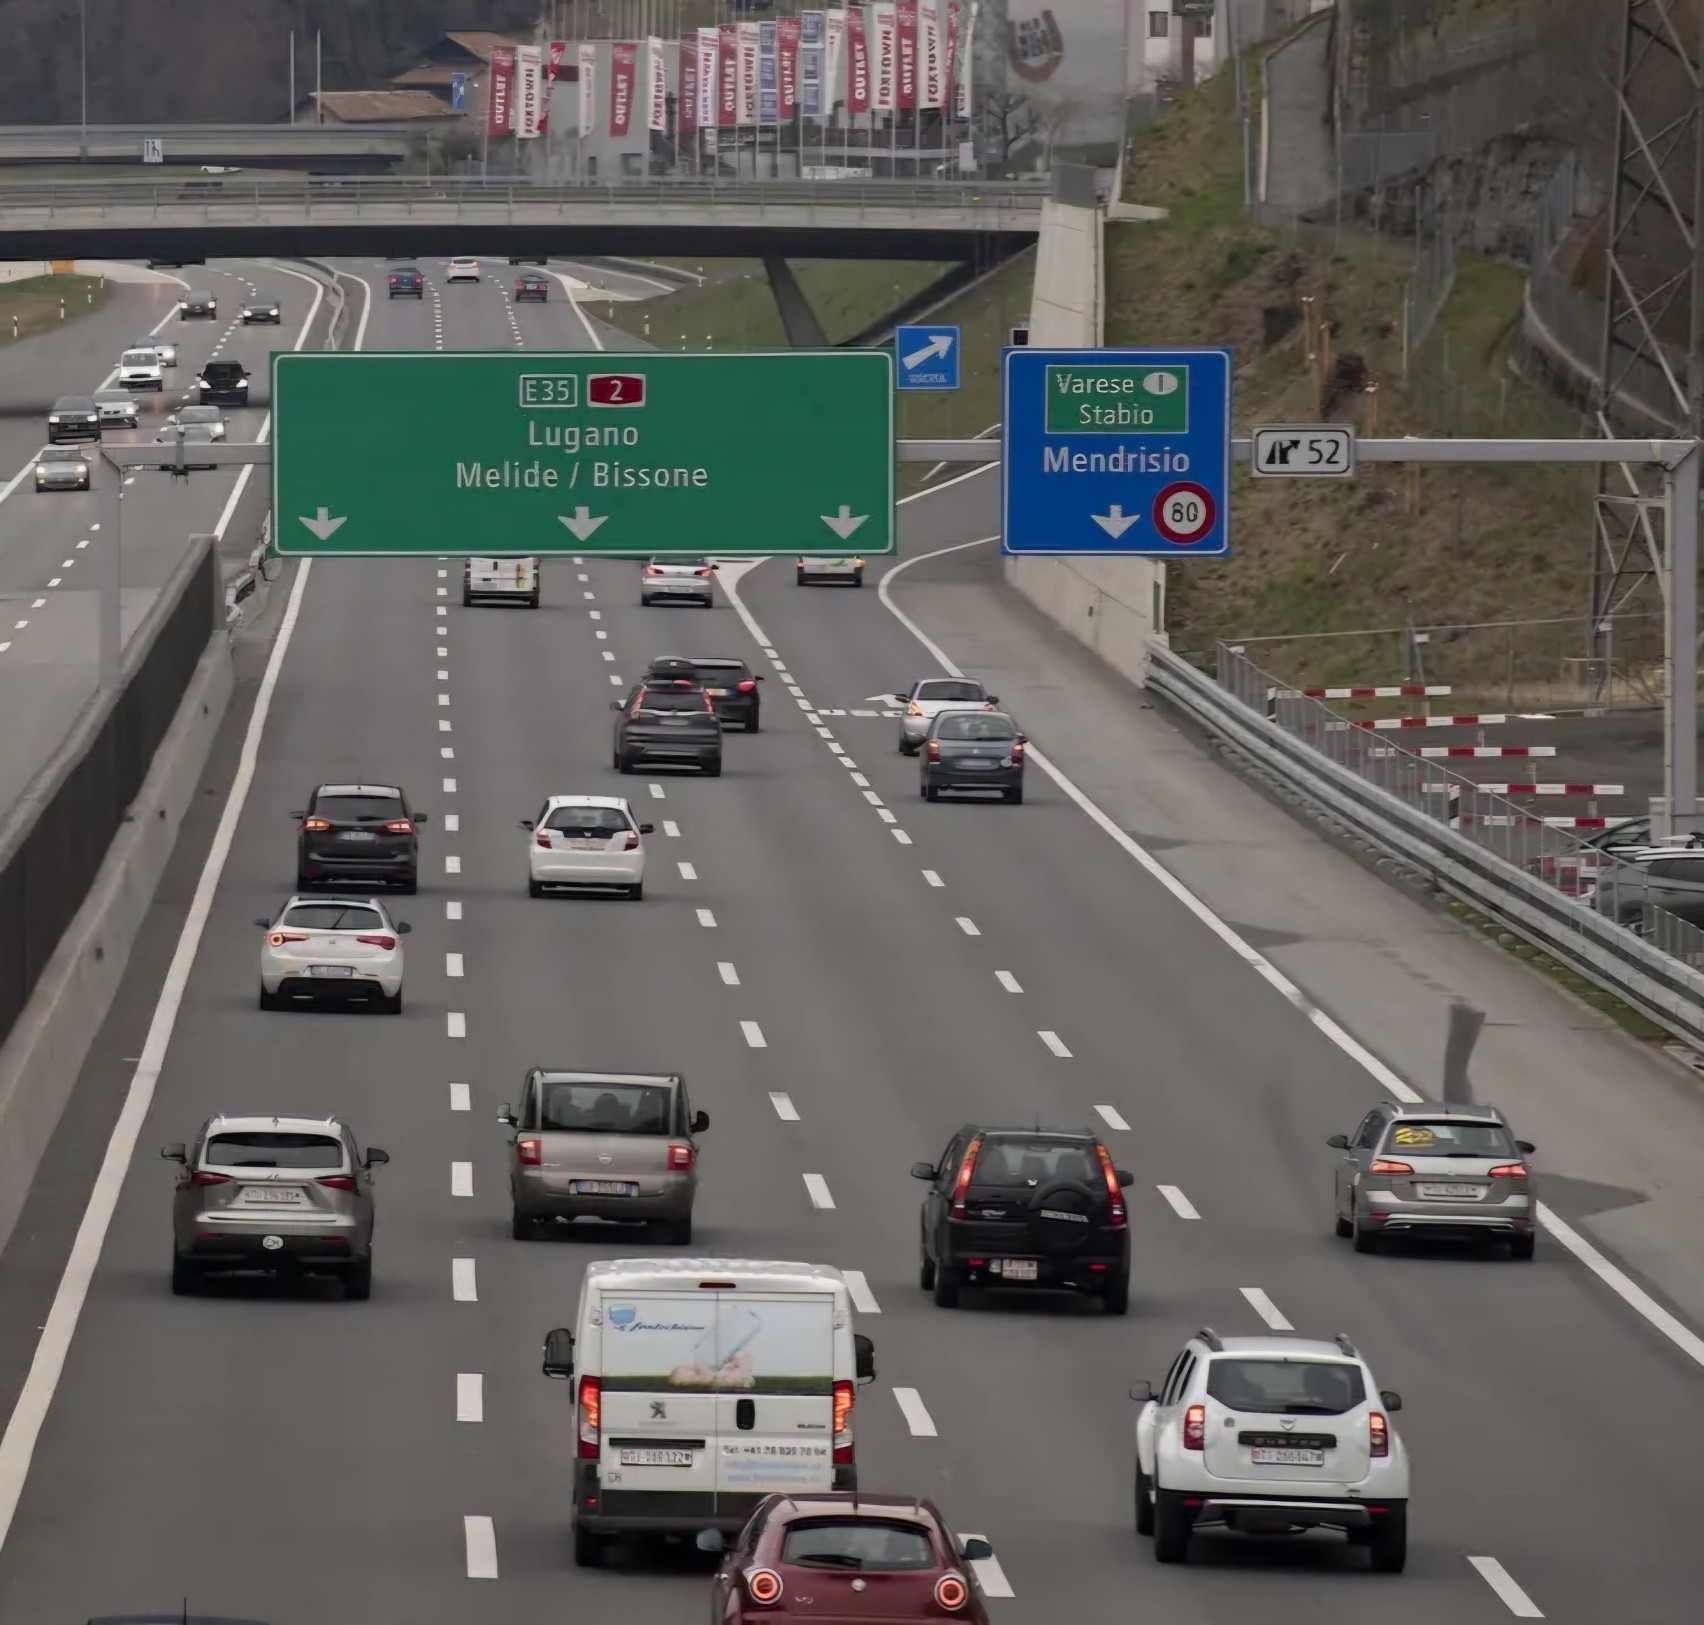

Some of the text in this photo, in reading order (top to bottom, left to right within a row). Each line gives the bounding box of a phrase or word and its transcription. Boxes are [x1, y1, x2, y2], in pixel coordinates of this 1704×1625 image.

[526, 379, 623, 401] E35 2
[1056, 373, 1134, 394] Varese
[1079, 402, 1154, 425] Stabio
[529, 420, 639, 454] Lugano
[1043, 445, 1190, 473] Mendrisio
[1308, 439, 1340, 465] 52
[456, 460, 708, 489] Melide / Bissone
